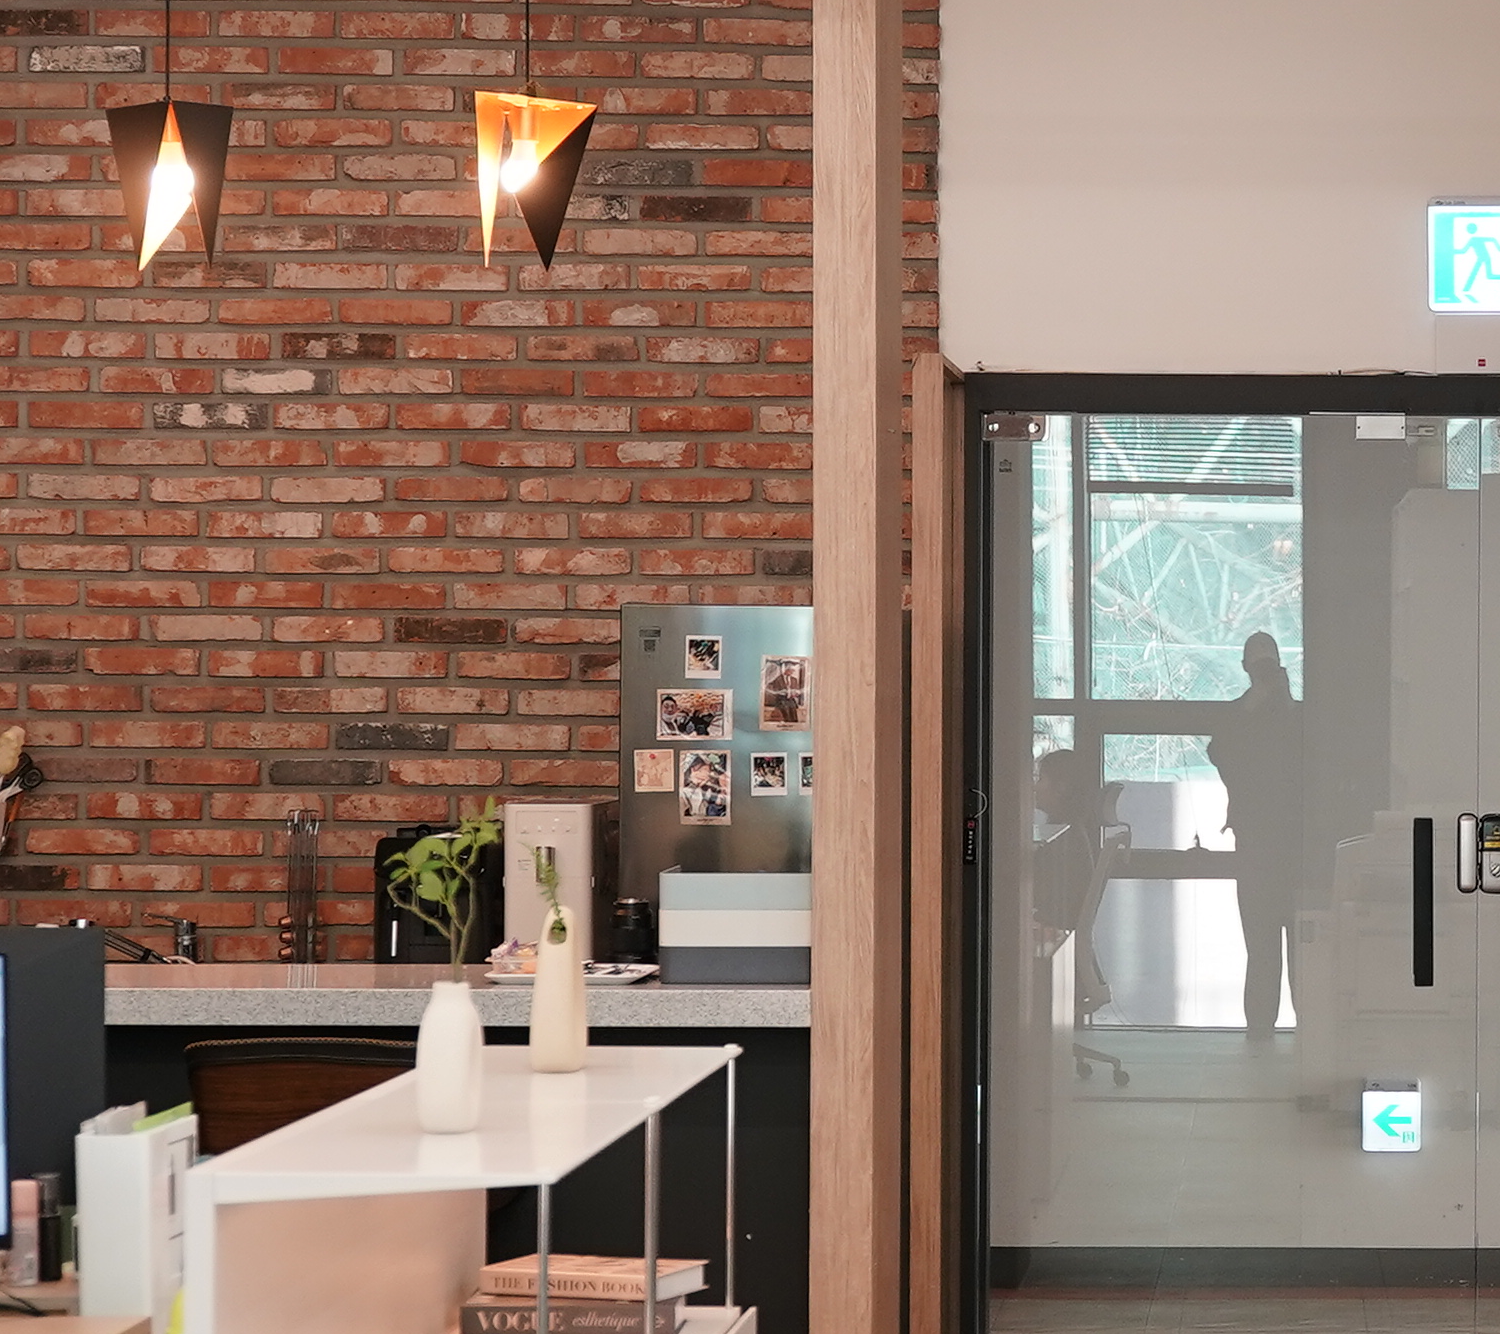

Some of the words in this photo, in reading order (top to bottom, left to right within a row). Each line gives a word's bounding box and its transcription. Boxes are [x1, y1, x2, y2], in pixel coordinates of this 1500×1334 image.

[493, 1277, 522, 1289] THE
[527, 1278, 597, 1292] FSHION
[601, 1281, 645, 1294] BOOK
